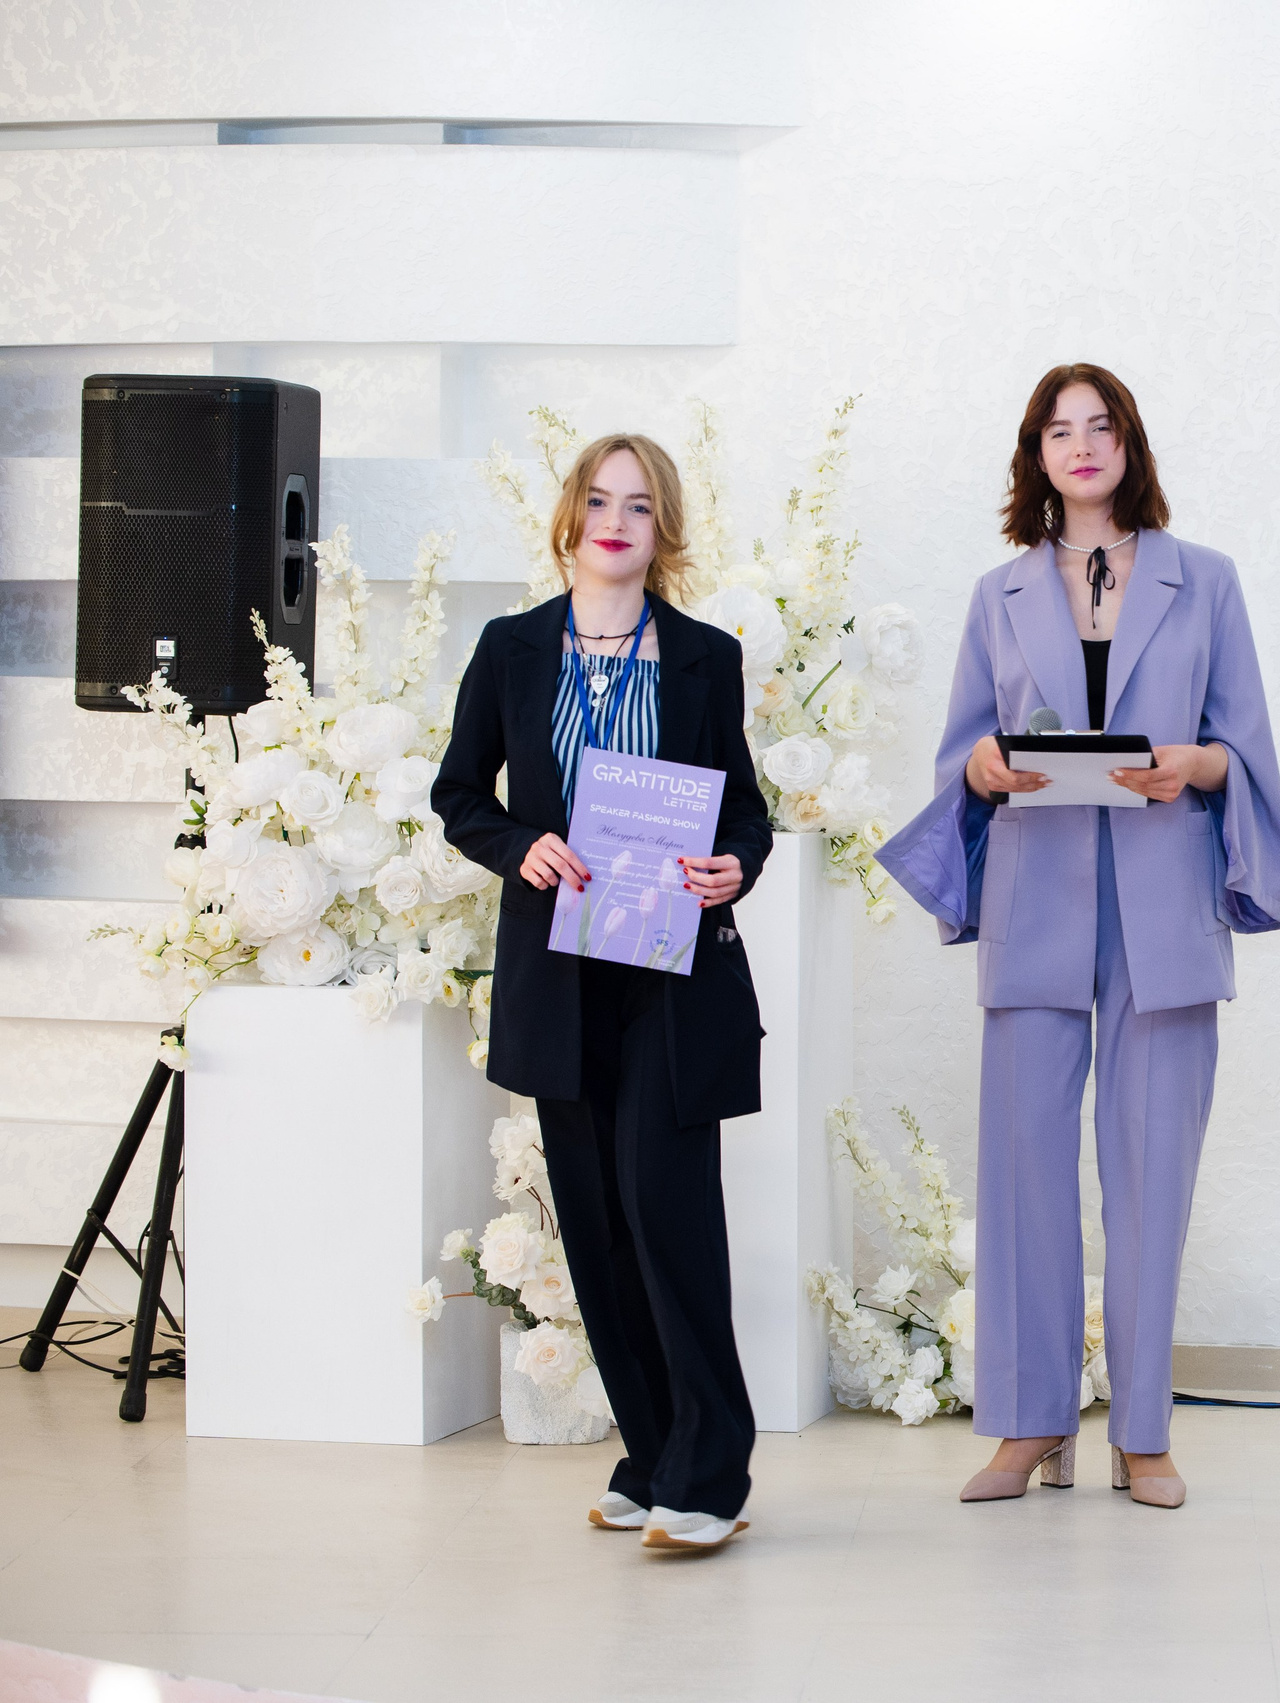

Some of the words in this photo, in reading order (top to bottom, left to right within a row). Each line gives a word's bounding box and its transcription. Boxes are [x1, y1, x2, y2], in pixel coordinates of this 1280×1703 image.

[592, 763, 712, 799] GRATITUDE
[590, 804, 631, 818] SPEAKER
[632, 811, 671, 825] FASHION
[672, 818, 701, 830] SHOW
[663, 796, 708, 813] LETTER
